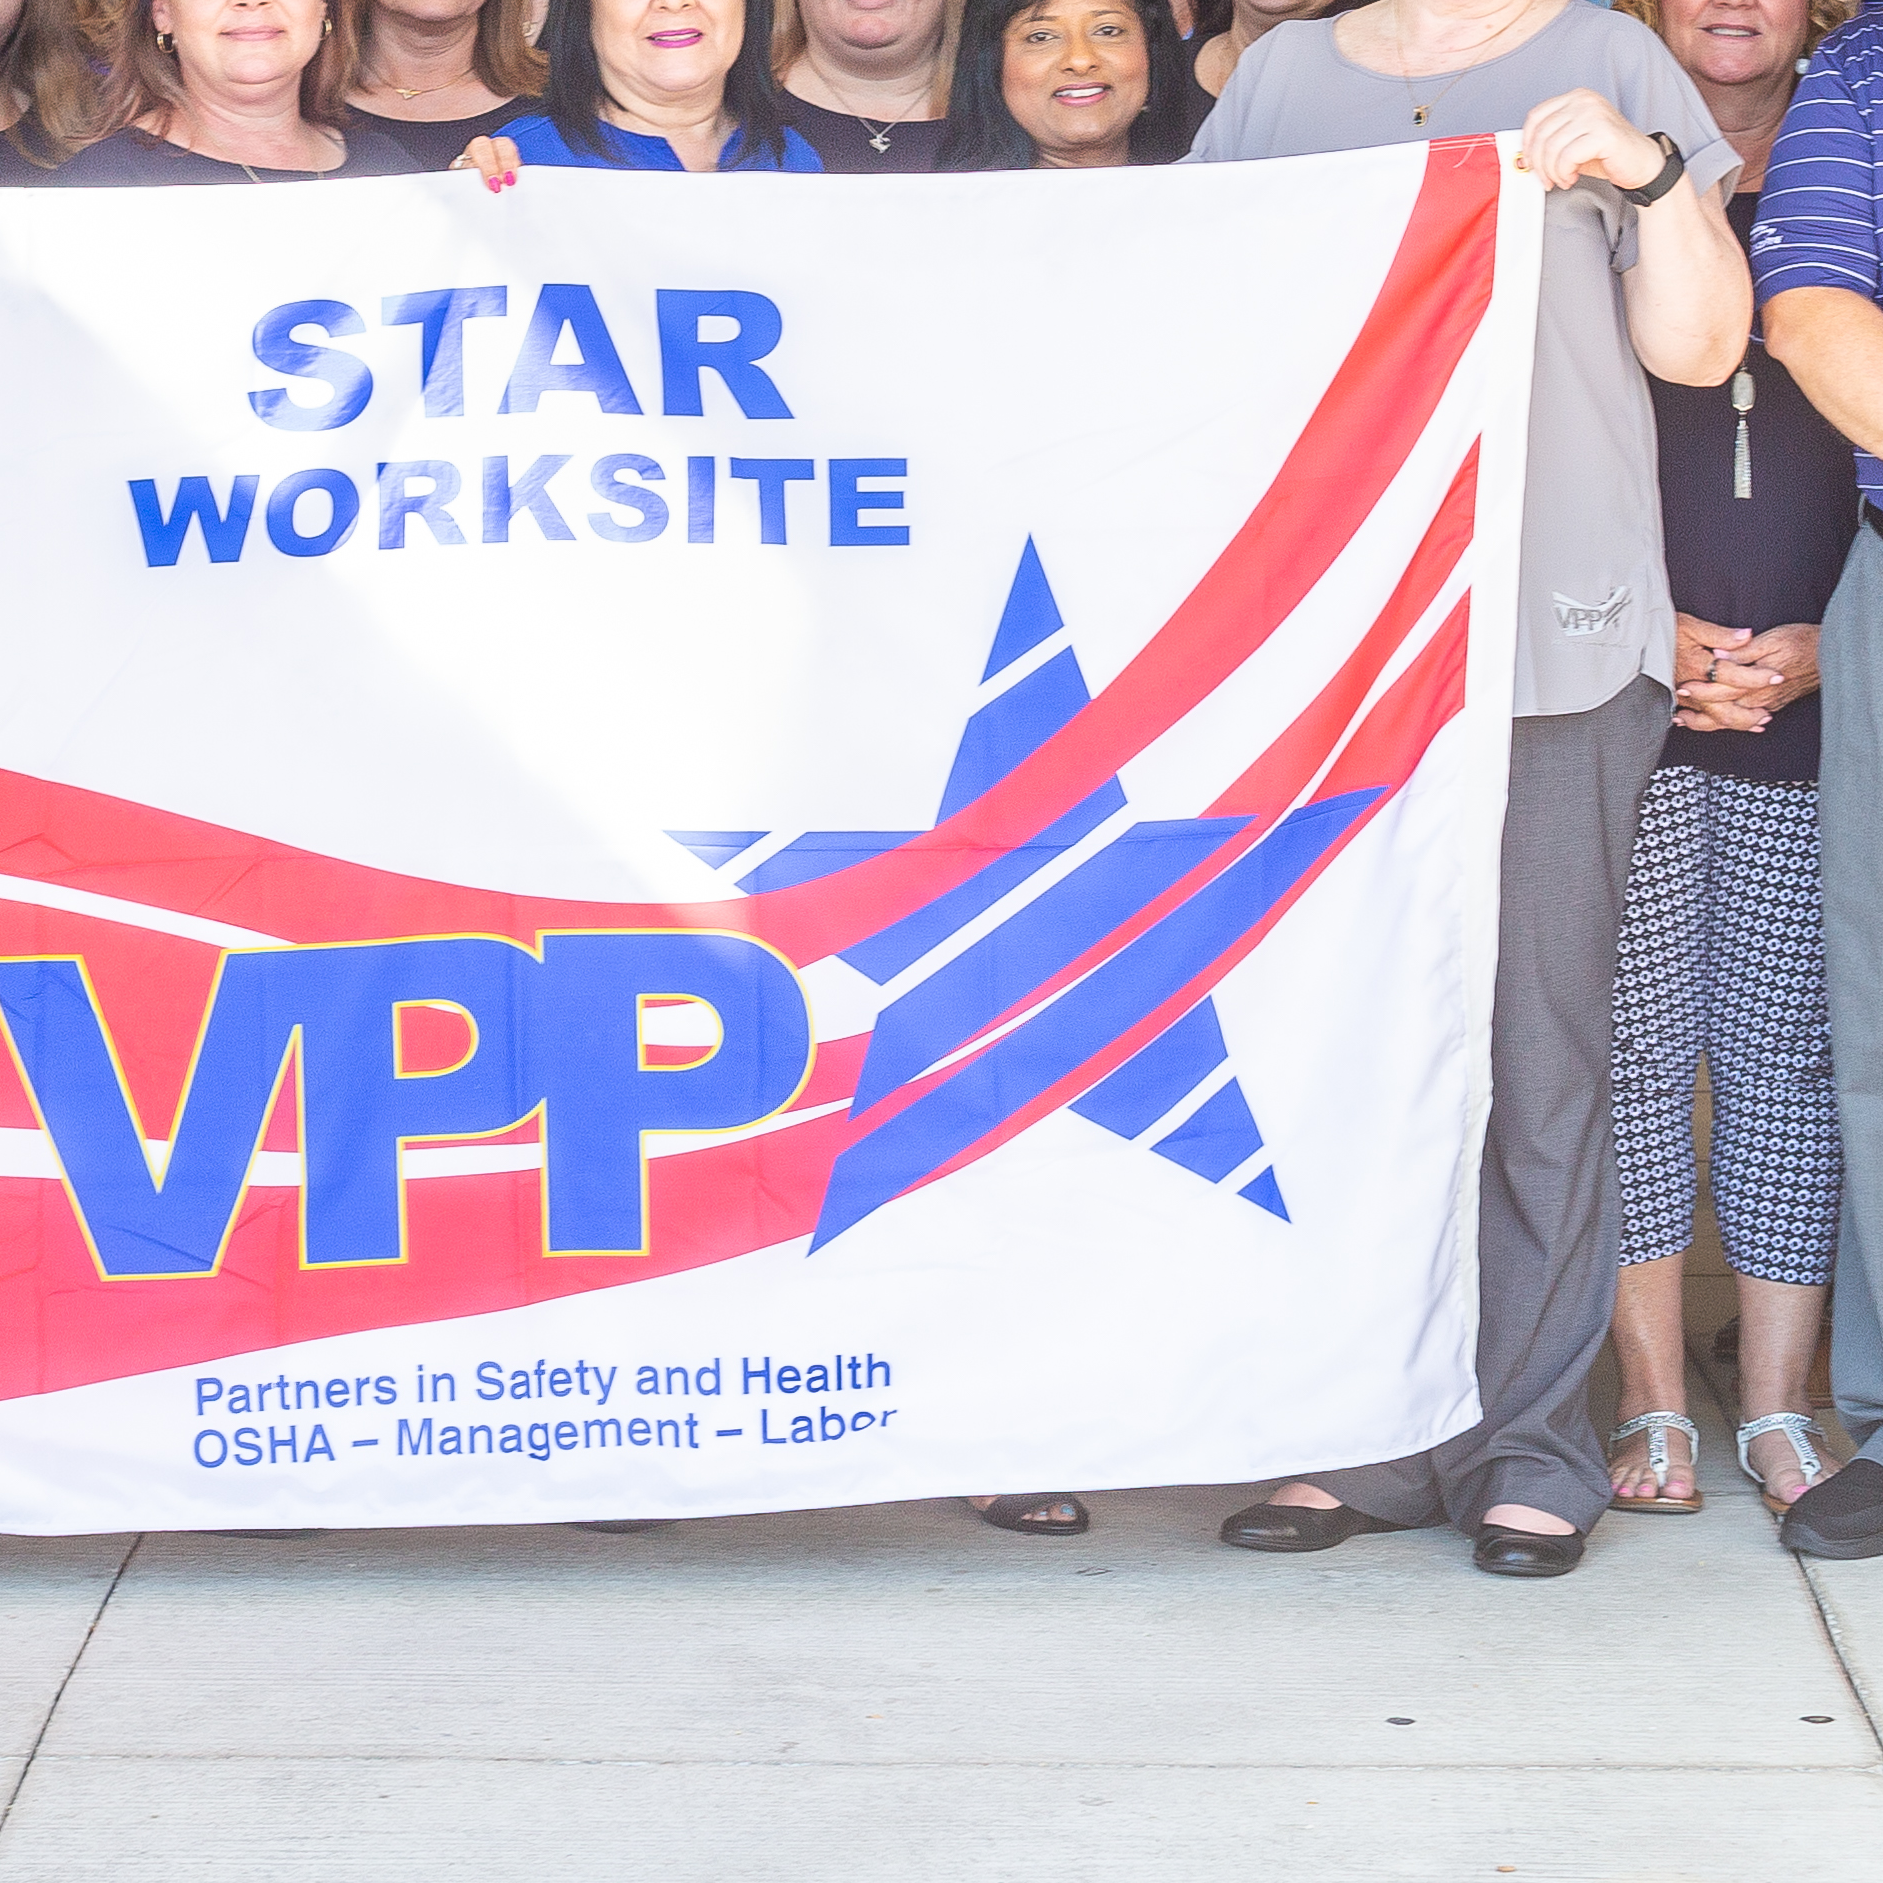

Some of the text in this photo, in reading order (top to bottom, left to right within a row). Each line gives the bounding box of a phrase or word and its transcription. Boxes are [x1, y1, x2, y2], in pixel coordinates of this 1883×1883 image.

[247, 283, 796, 432] STAR
[127, 453, 911, 568] WORKSITE
[195, 1353, 891, 1416] Partners in Safety and Health
[193, 1423, 336, 1468] OSHA
[396, 1412, 700, 1462] Management
[760, 1406, 898, 1445] Labor
